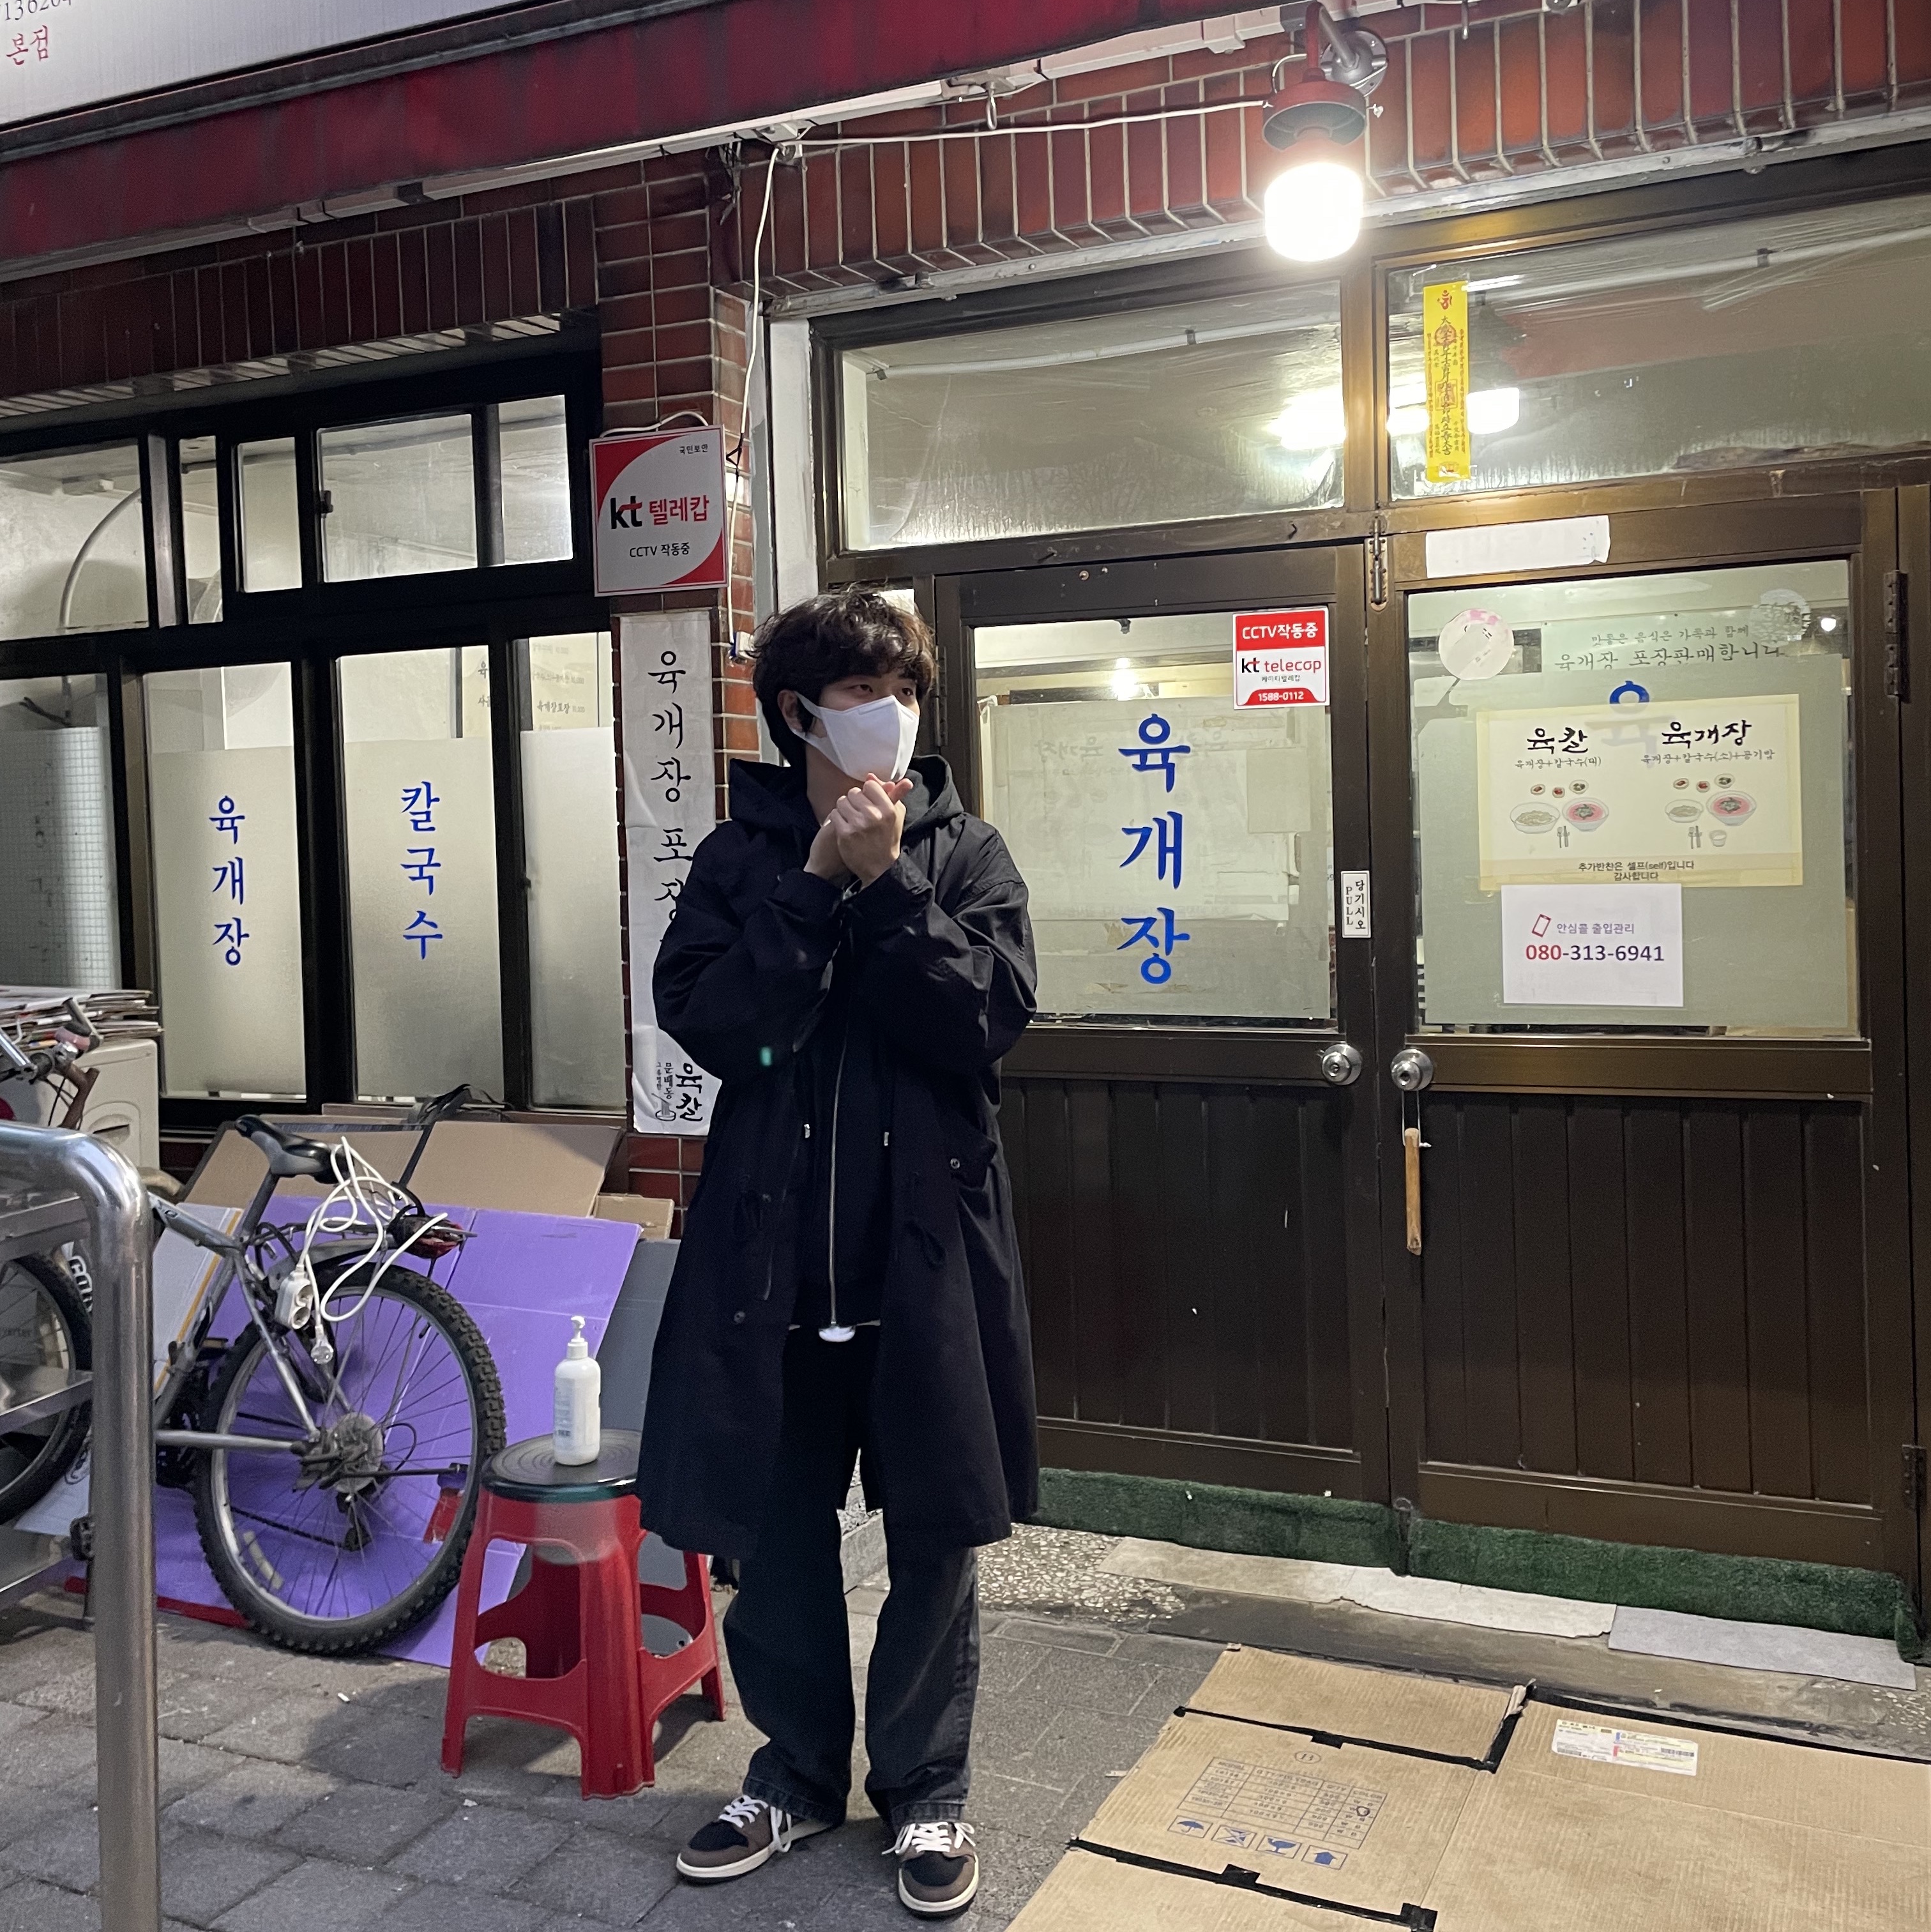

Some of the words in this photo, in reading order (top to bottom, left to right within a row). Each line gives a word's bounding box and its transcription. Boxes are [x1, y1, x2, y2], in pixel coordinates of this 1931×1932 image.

[6, 25, 49, 65] 본점
[679, 444, 708, 455] 국민보안
[610, 496, 642, 529] kt
[649, 494, 710, 526] 텔레캅
[630, 545, 658, 558] CCTV
[660, 542, 690, 556] 작동중
[1635, 630, 1672, 643] 음식은
[1241, 657, 1261, 673] kt
[1264, 658, 1322, 674] telecop
[1555, 651, 1618, 671] 육개장
[1258, 691, 1304, 701] 1588-0112
[647, 651, 692, 803] 육개장
[1527, 727, 1588, 754] 육칼
[1662, 719, 1752, 749] 육개장
[1117, 713, 1192, 985] 육개장
[209, 795, 250, 966] 육개장
[400, 780, 443, 960] 칼국수
[1345, 886, 1354, 925] PULL
[1354, 879, 1367, 930] 당기시오
[1557, 923, 1588, 934] 안심콜
[1592, 923, 1635, 934] 출입관리
[1526, 945, 1665, 961] 080-313-6941
[676, 1062, 703, 1122] 육칼
